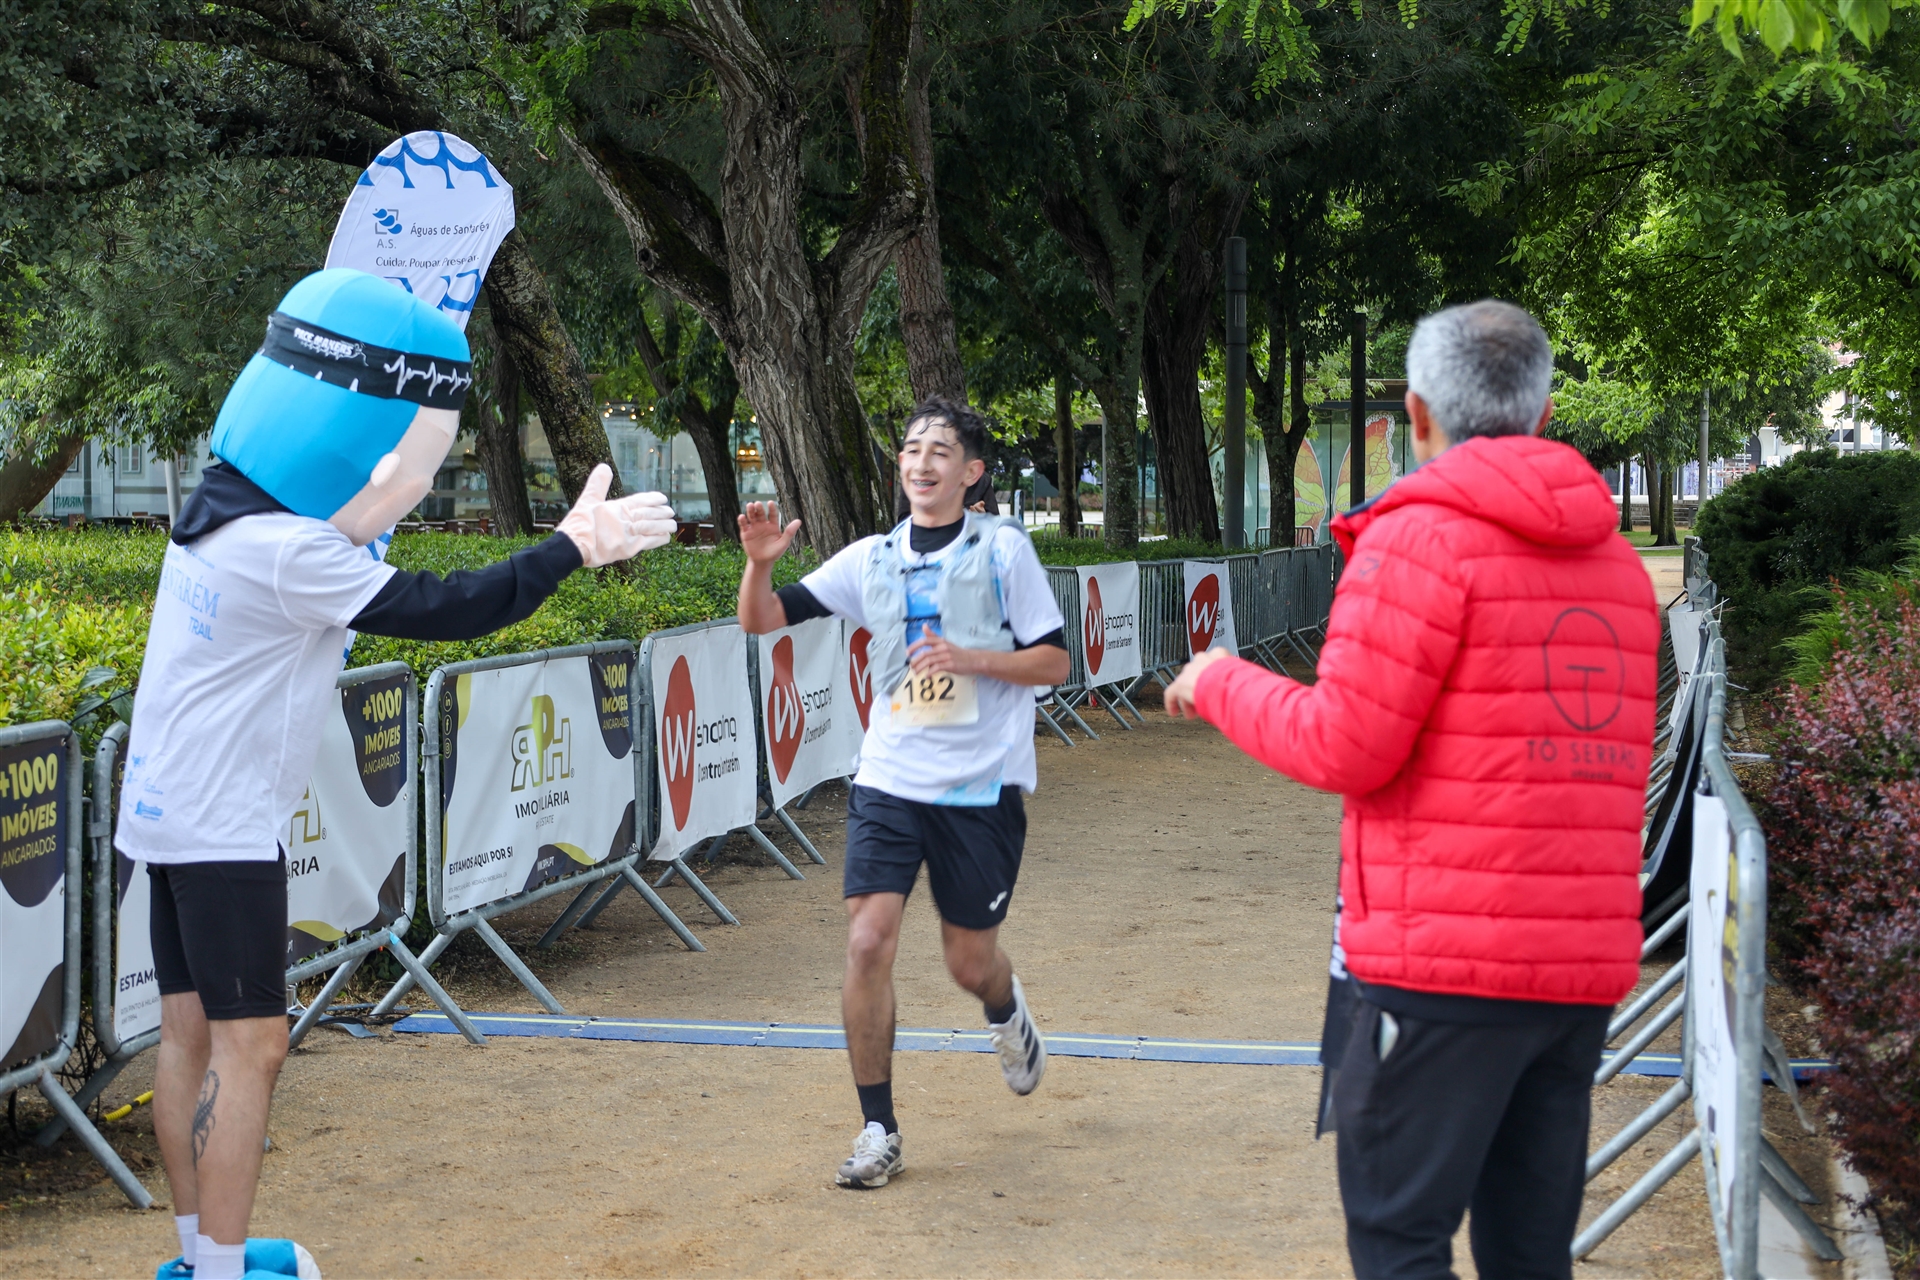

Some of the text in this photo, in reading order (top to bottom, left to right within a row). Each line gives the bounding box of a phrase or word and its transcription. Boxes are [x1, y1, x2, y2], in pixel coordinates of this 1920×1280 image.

[376, 238, 397, 249] A.S.
[410, 222, 438, 238] Águas
[440, 225, 451, 235] de
[375, 256, 407, 268] Cuidar.
[188, 616, 213, 641] TRAIL
[903, 675, 955, 703] 182
[363, 687, 402, 723] +1000
[365, 725, 401, 755] IMÓVEIS
[0, 753, 58, 800] +1000
[363, 751, 401, 776] ANGARIADOS
[1, 801, 57, 842] IMÓVEIS
[1, 834, 57, 869] ANGARIADOS
[449, 846, 514, 876] ESTAMOS AQUI POR SI
